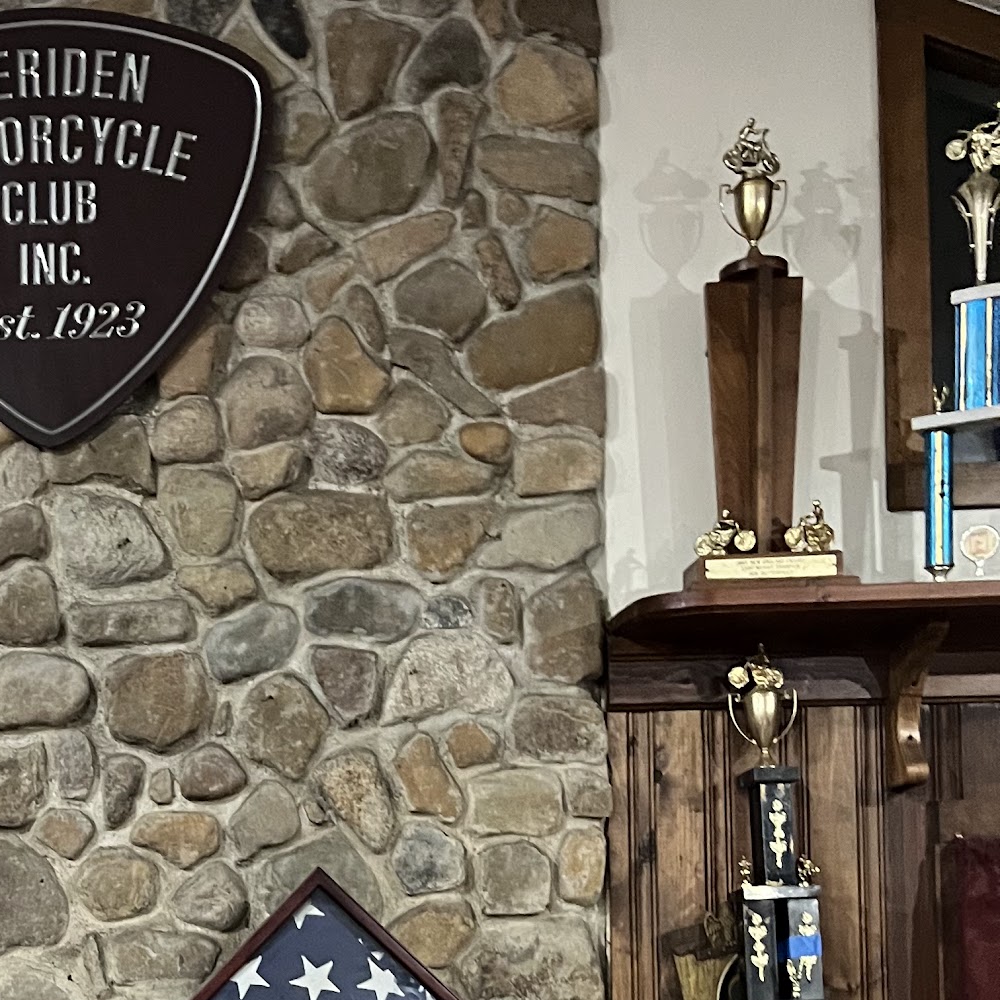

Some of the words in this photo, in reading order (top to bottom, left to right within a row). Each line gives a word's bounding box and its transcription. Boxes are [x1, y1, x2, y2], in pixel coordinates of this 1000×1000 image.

[1, 181, 97, 226] CLUB
[19, 242, 91, 286] INC.
[46, 301, 146, 340] 1923
